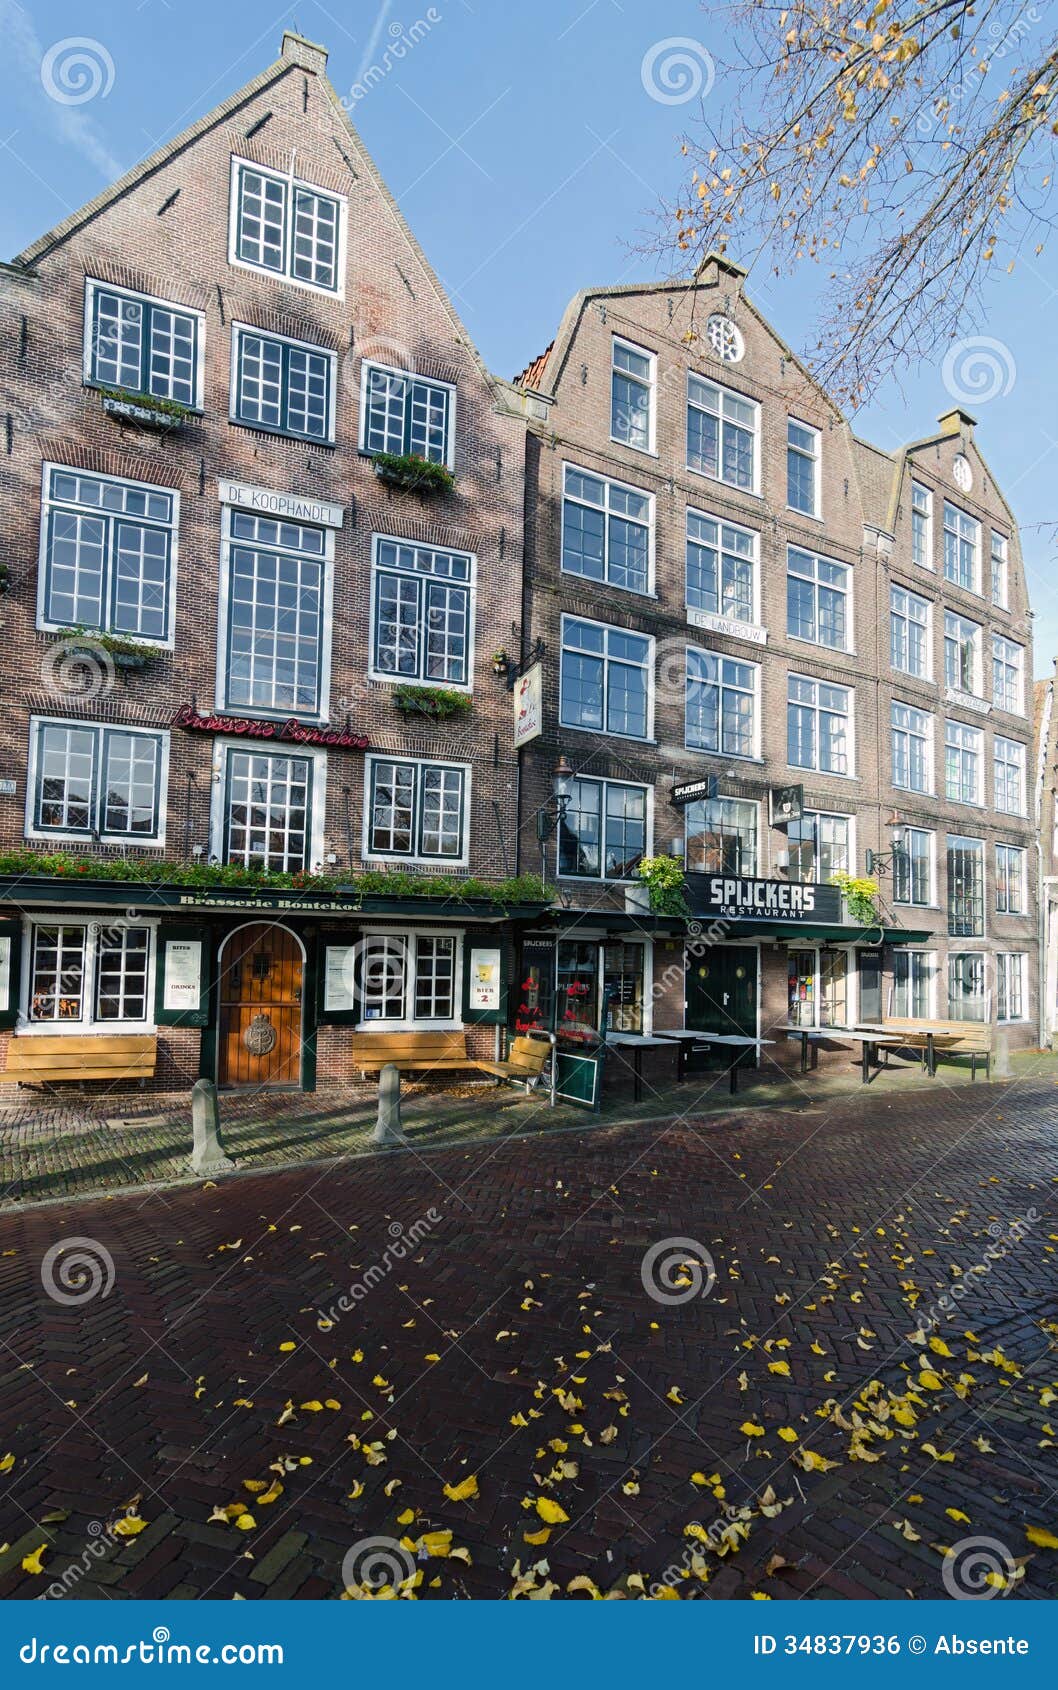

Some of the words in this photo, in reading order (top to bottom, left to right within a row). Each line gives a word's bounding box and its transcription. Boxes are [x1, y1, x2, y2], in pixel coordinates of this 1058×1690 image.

[228, 486, 246, 504] DE
[252, 490, 336, 524] KOOPHANDEL
[694, 613, 708, 627] DE
[709, 878, 815, 911] SPIJCKERS
[179, 895, 273, 908] Brasserie
[278, 900, 363, 912] Bontekoe
[720, 905, 805, 918] RESTAURANT
[480, 994, 489, 1002] 2
